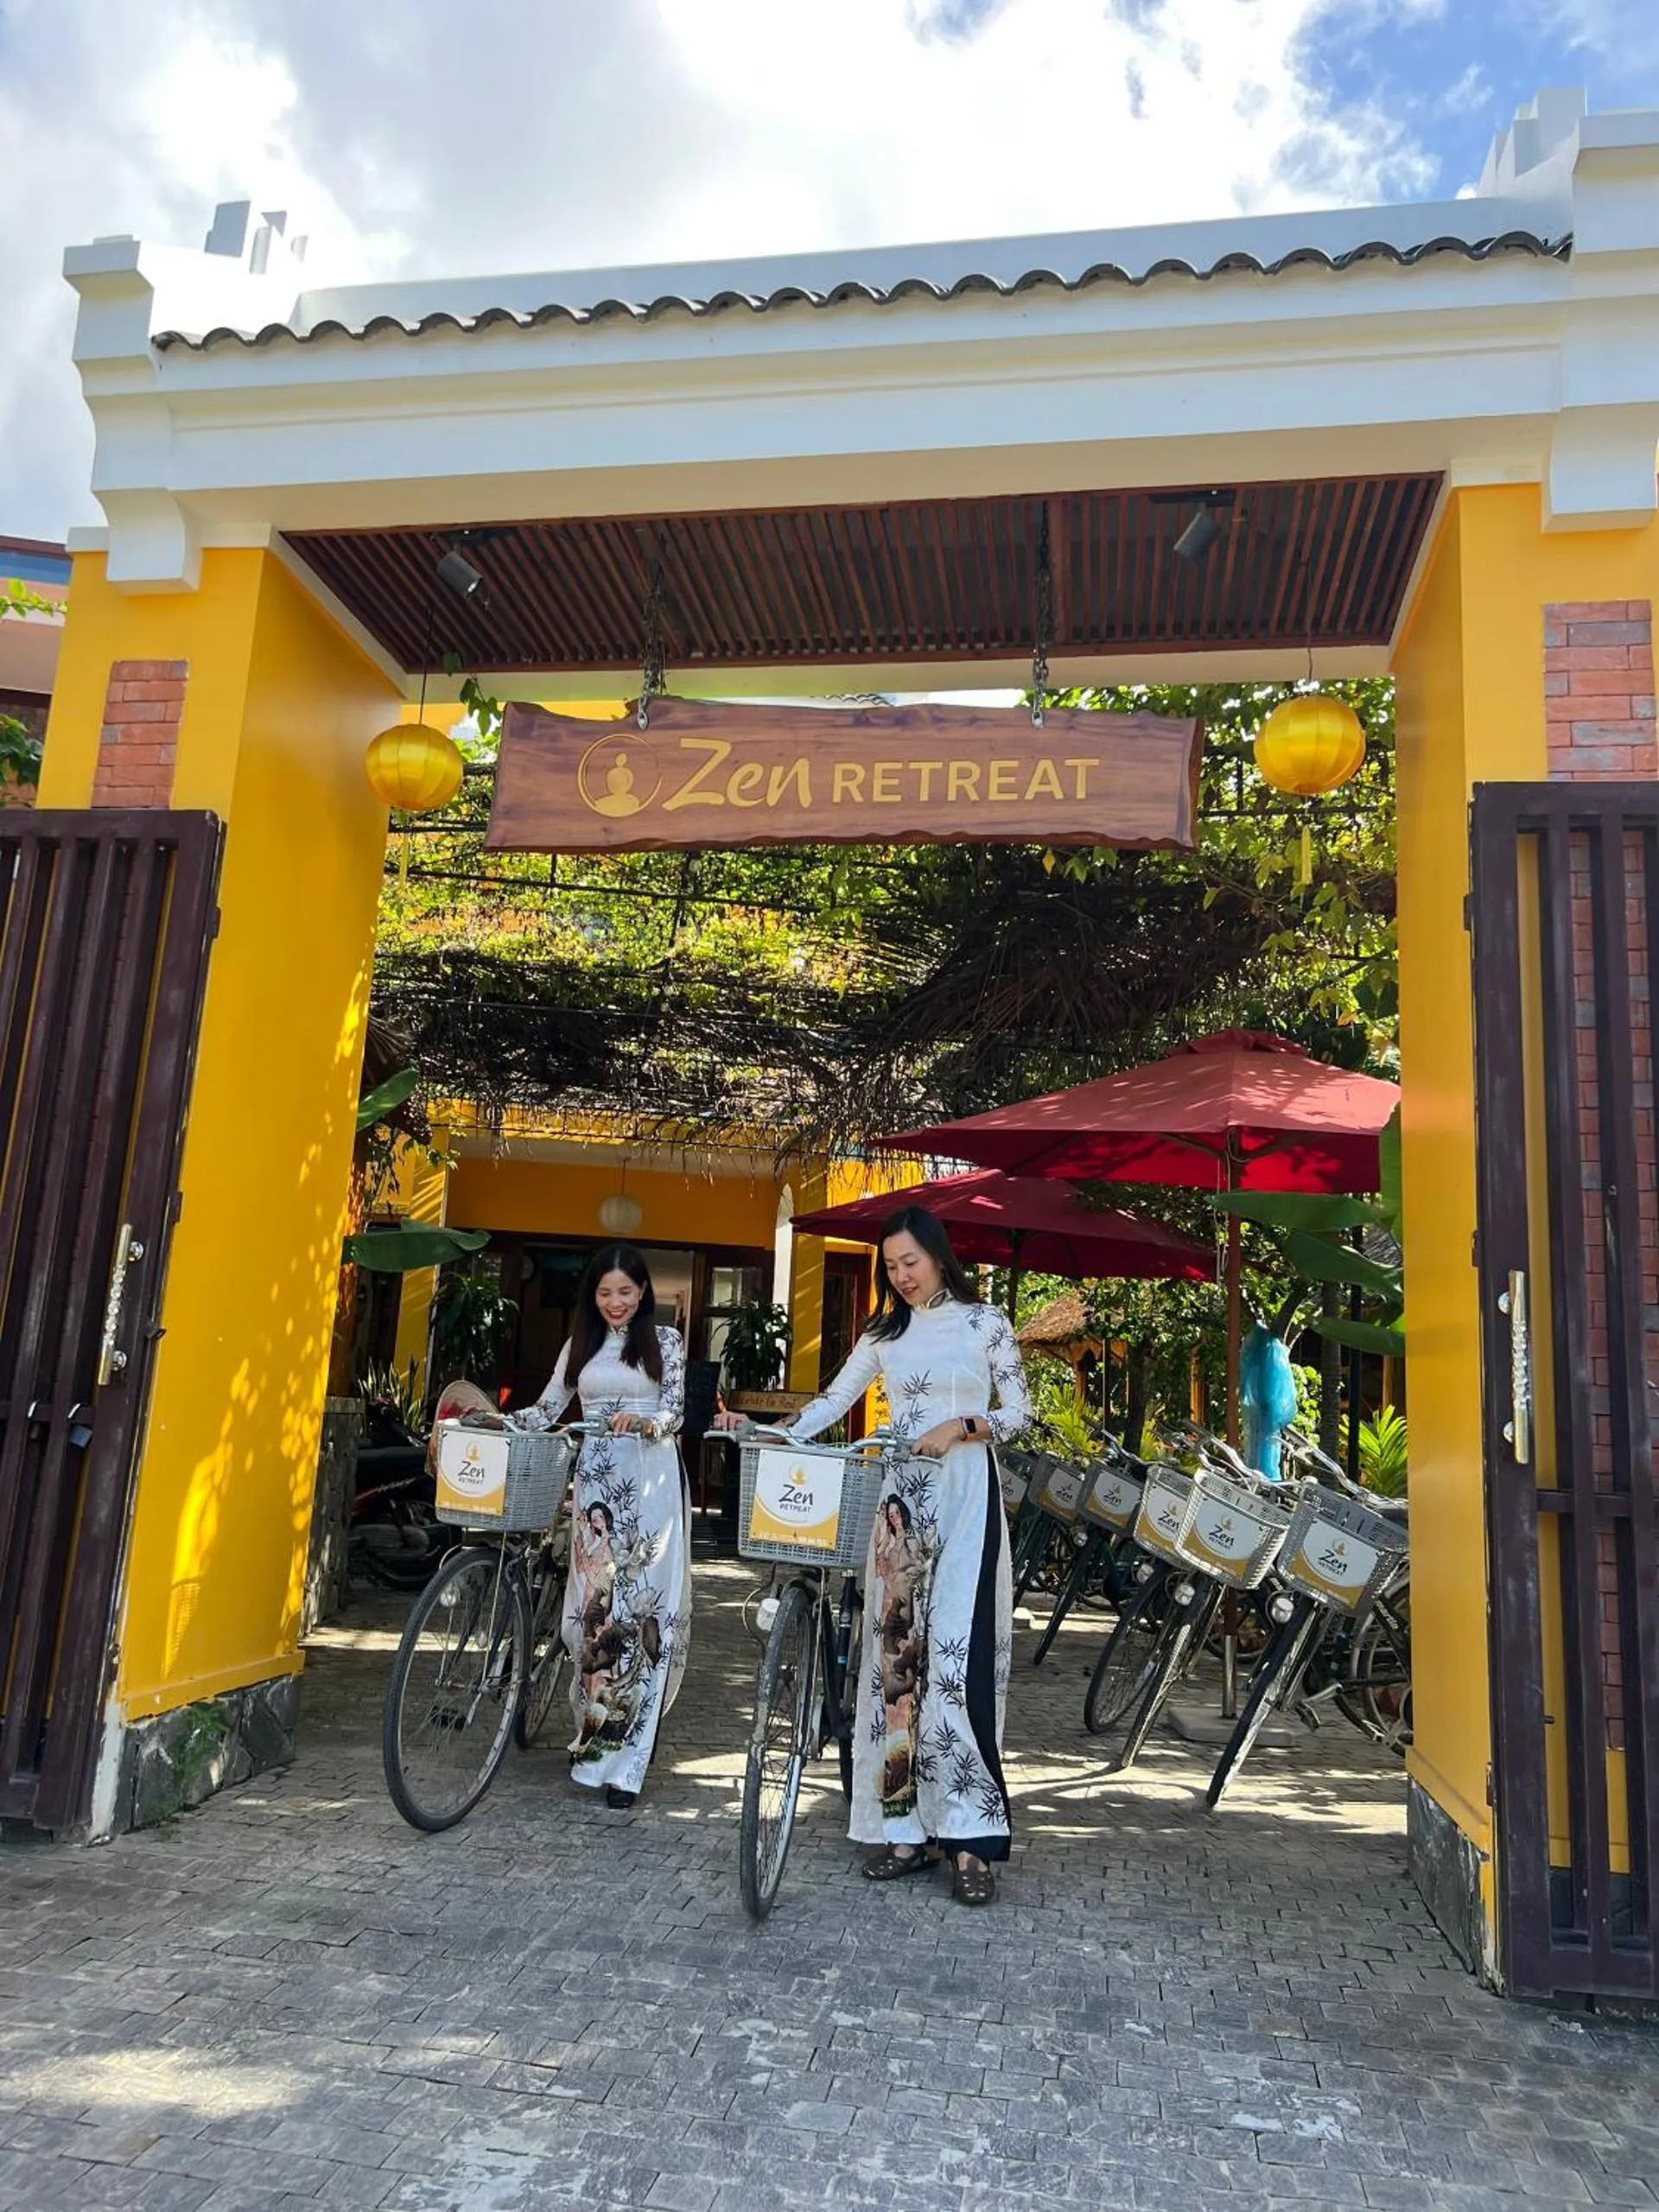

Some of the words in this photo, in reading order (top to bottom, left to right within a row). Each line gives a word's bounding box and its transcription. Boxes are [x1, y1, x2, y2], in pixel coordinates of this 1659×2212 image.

[662, 737, 812, 811] Zen
[831, 757, 1101, 804] RETREAT
[458, 1460, 485, 1479] Zen
[779, 1484, 814, 1506] Zen
[1158, 1510, 1179, 1529] Zen
[1209, 1524, 1235, 1547] Zen
[1319, 1548, 1348, 1573] Zen
